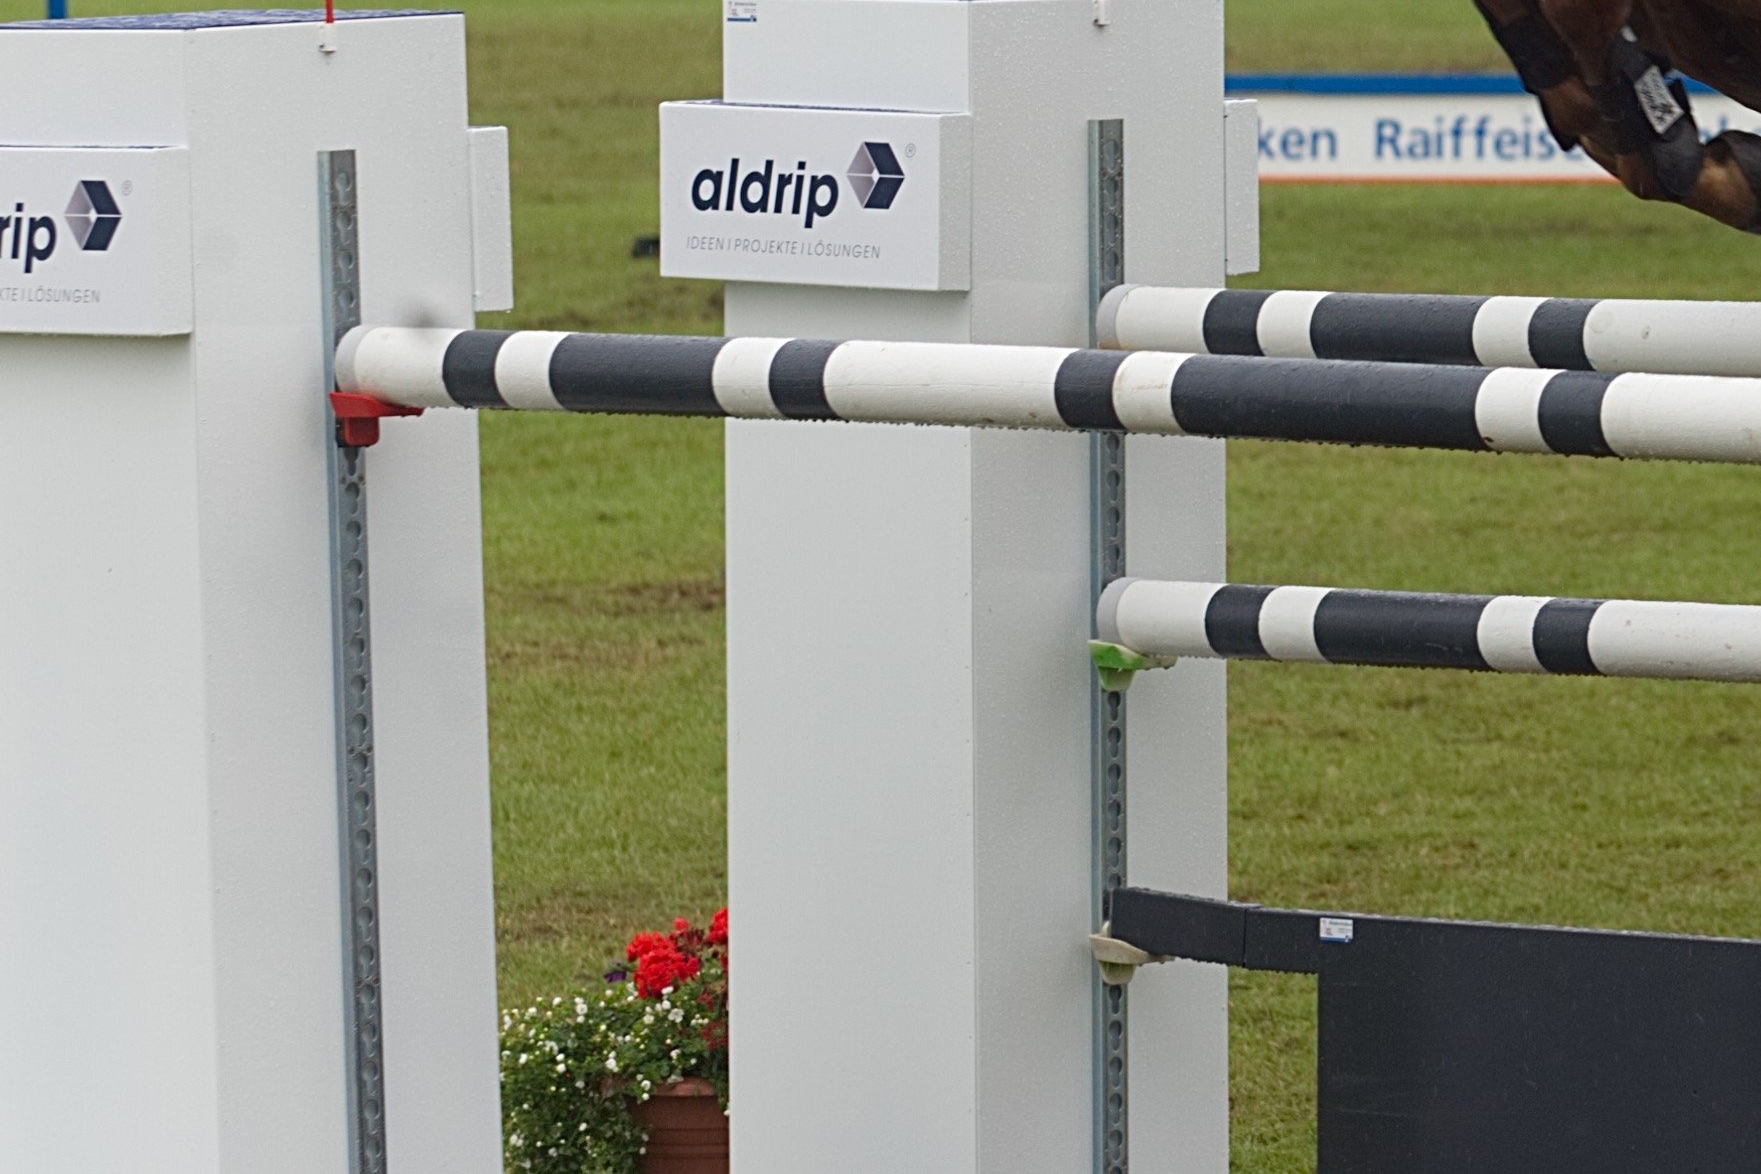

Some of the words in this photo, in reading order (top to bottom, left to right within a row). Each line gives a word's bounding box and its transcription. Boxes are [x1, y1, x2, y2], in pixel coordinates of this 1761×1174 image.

[691, 158, 839, 229] aldrip
[686, 235, 724, 252] IDEEN
[734, 237, 798, 256] PROJEKTE
[806, 239, 881, 260] LÖSUNGEN
[28, 285, 101, 303] LÖSUNGEN
